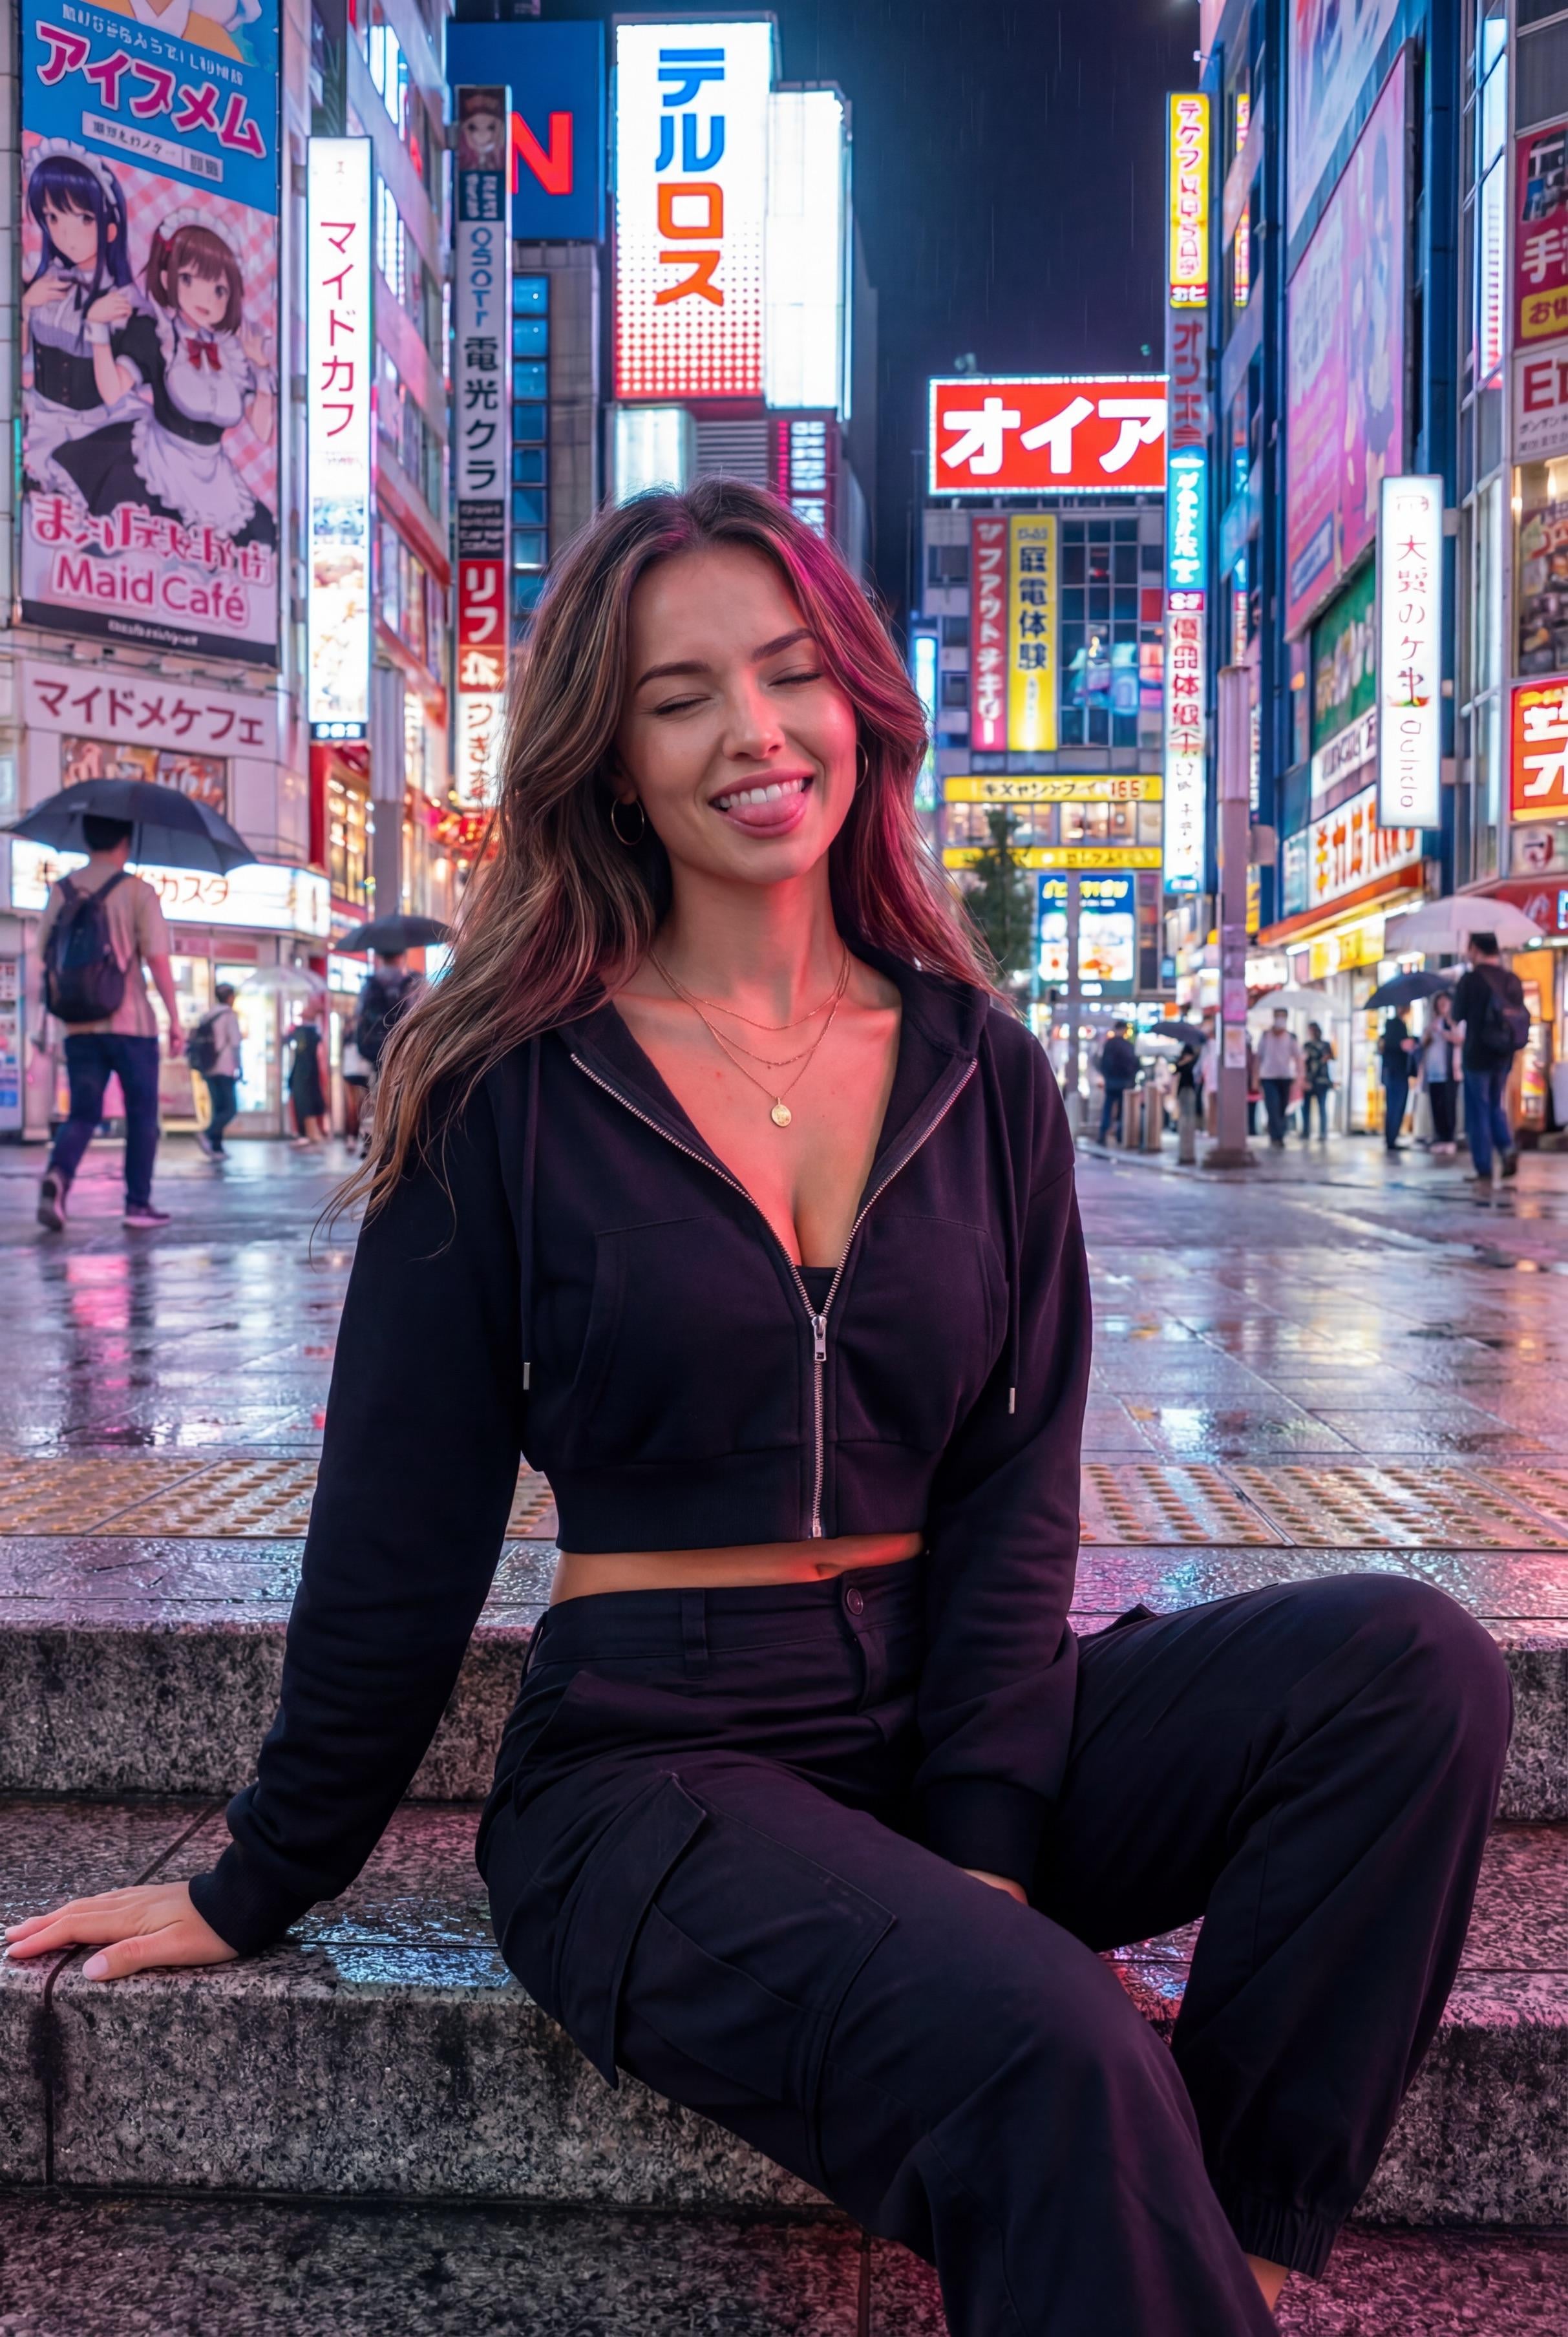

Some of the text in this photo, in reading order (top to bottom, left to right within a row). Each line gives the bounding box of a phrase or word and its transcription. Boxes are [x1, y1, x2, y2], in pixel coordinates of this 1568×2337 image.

[510, 111, 573, 195] N
[654, 47, 725, 306] テルロス
[464, 337, 499, 490] 電光クラ
[940, 396, 1168, 475] オイア
[57, 555, 246, 622] Maid Café
